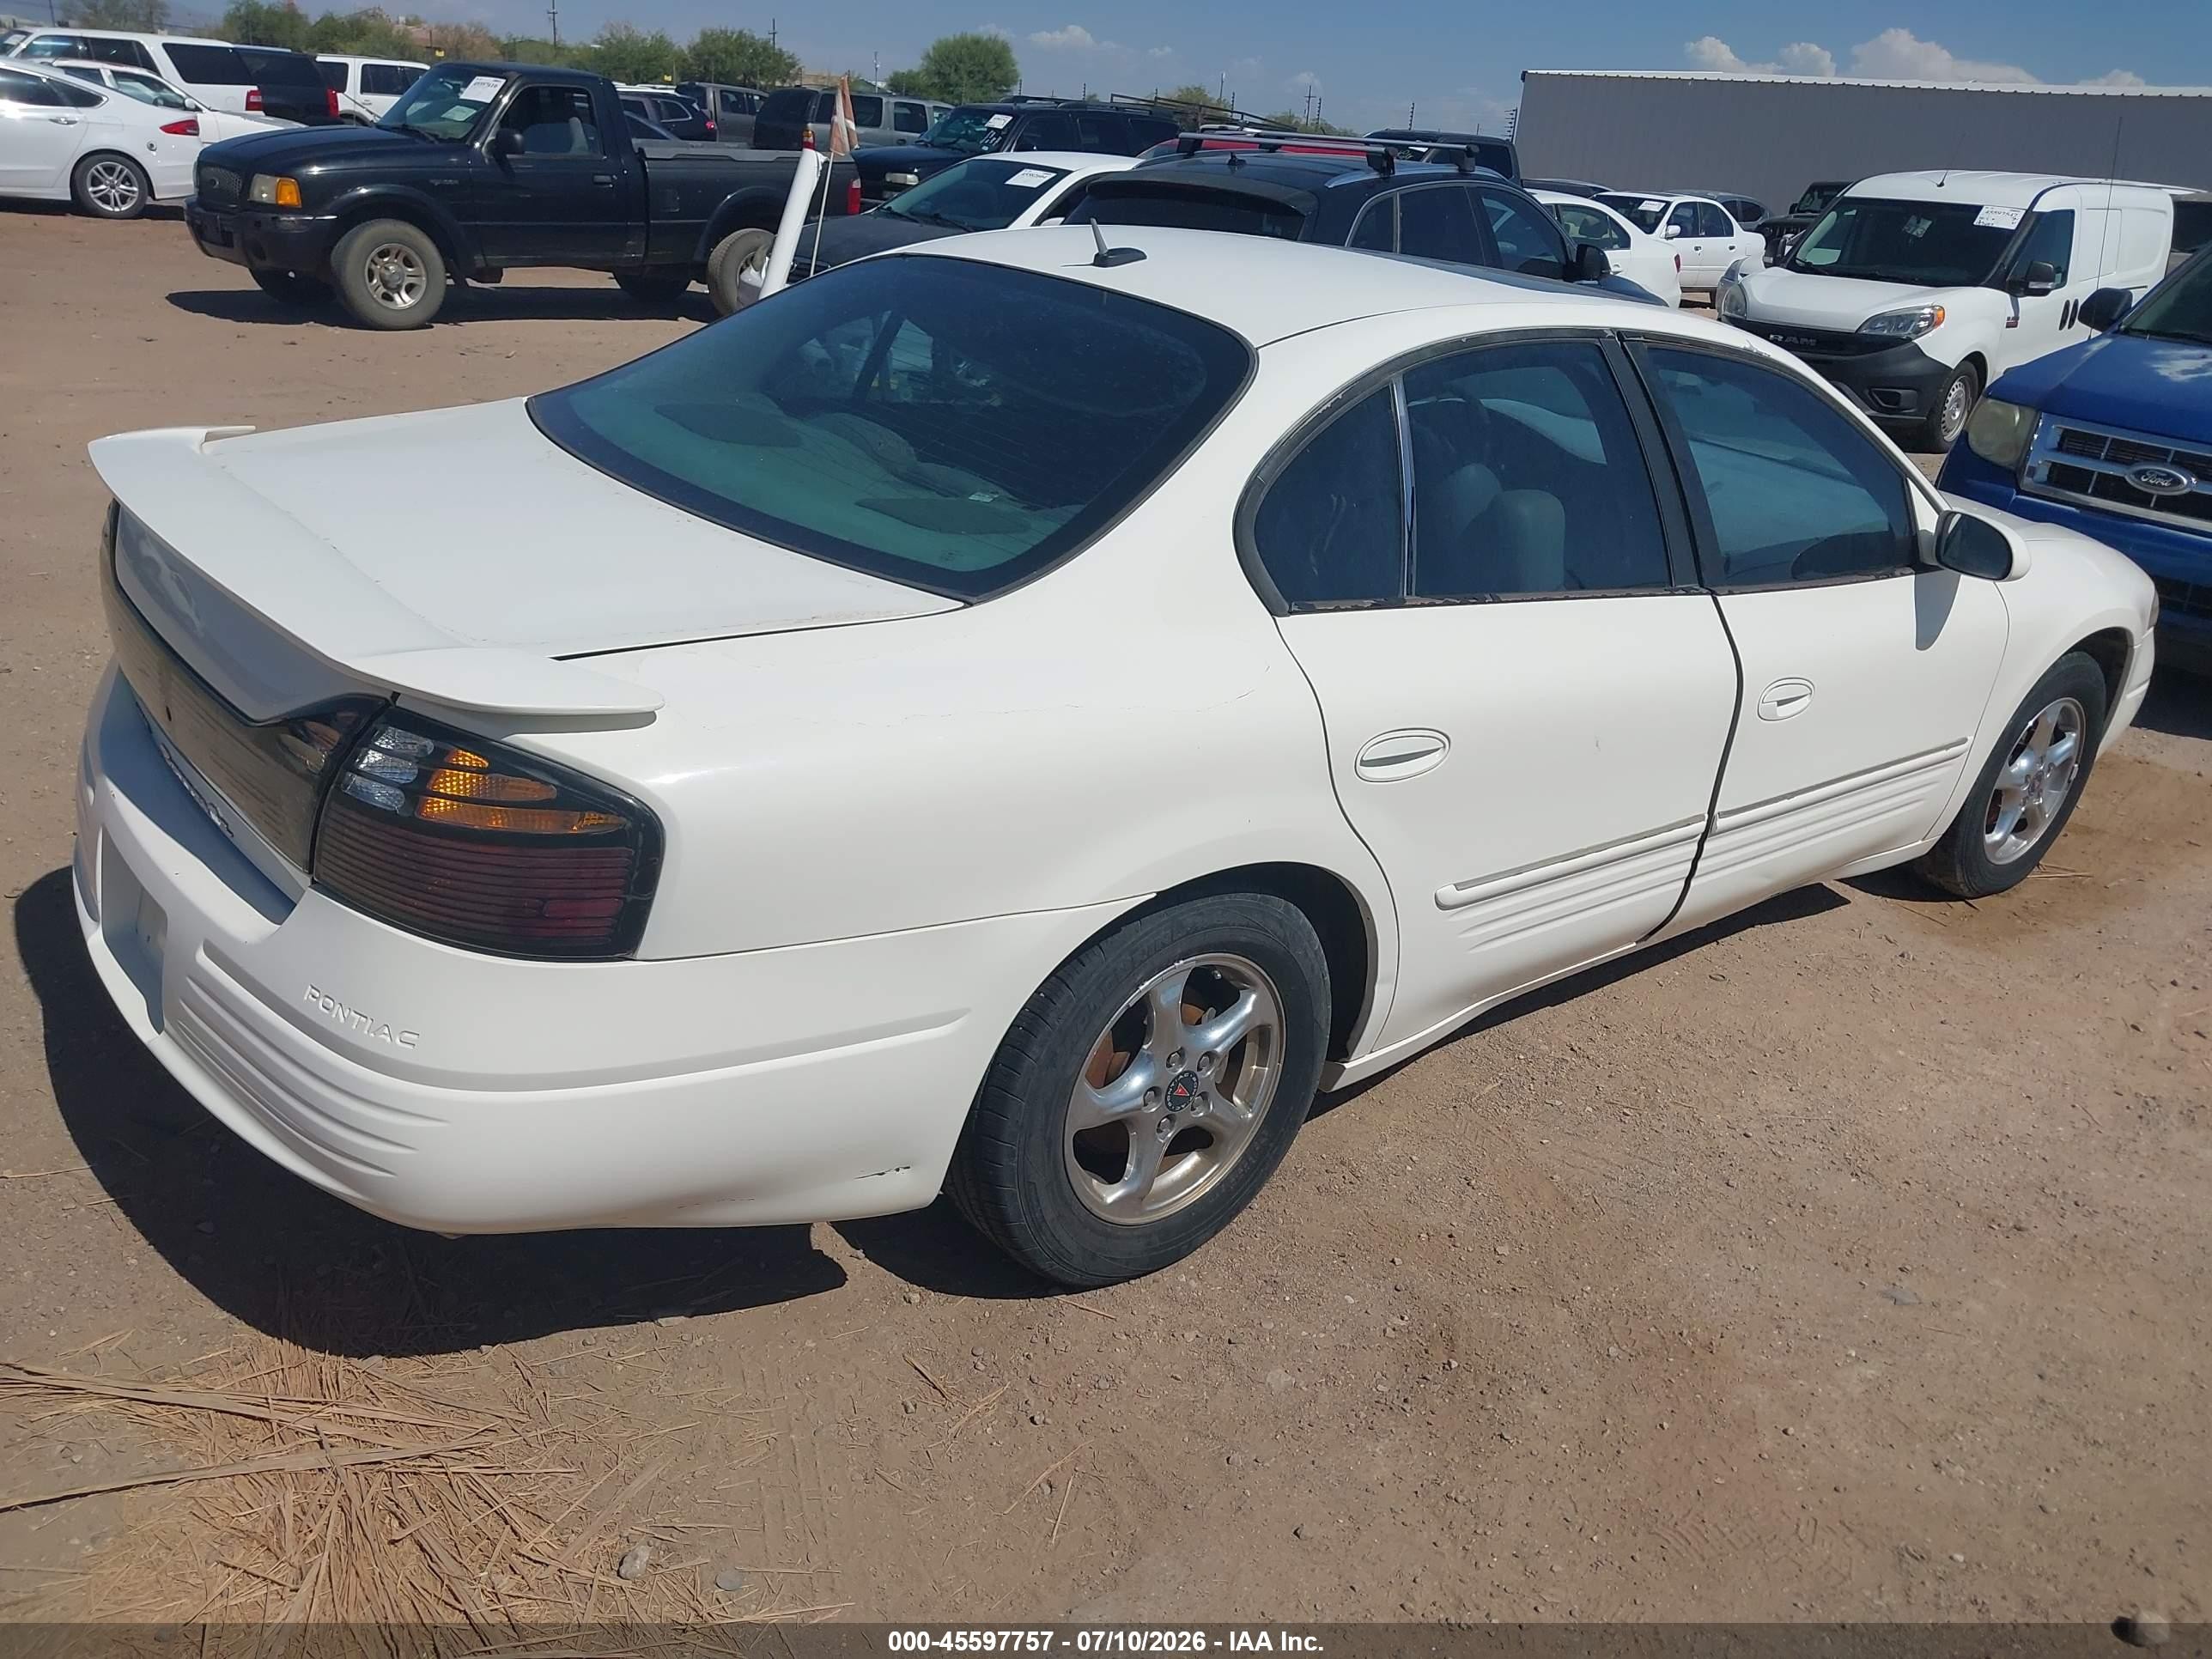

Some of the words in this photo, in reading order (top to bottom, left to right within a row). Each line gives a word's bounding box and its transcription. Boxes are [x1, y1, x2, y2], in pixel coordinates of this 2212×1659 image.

[1769, 334, 1817, 346] RAM
[2141, 470, 2172, 487] Ford
[303, 983, 420, 1049] PONTIAC
